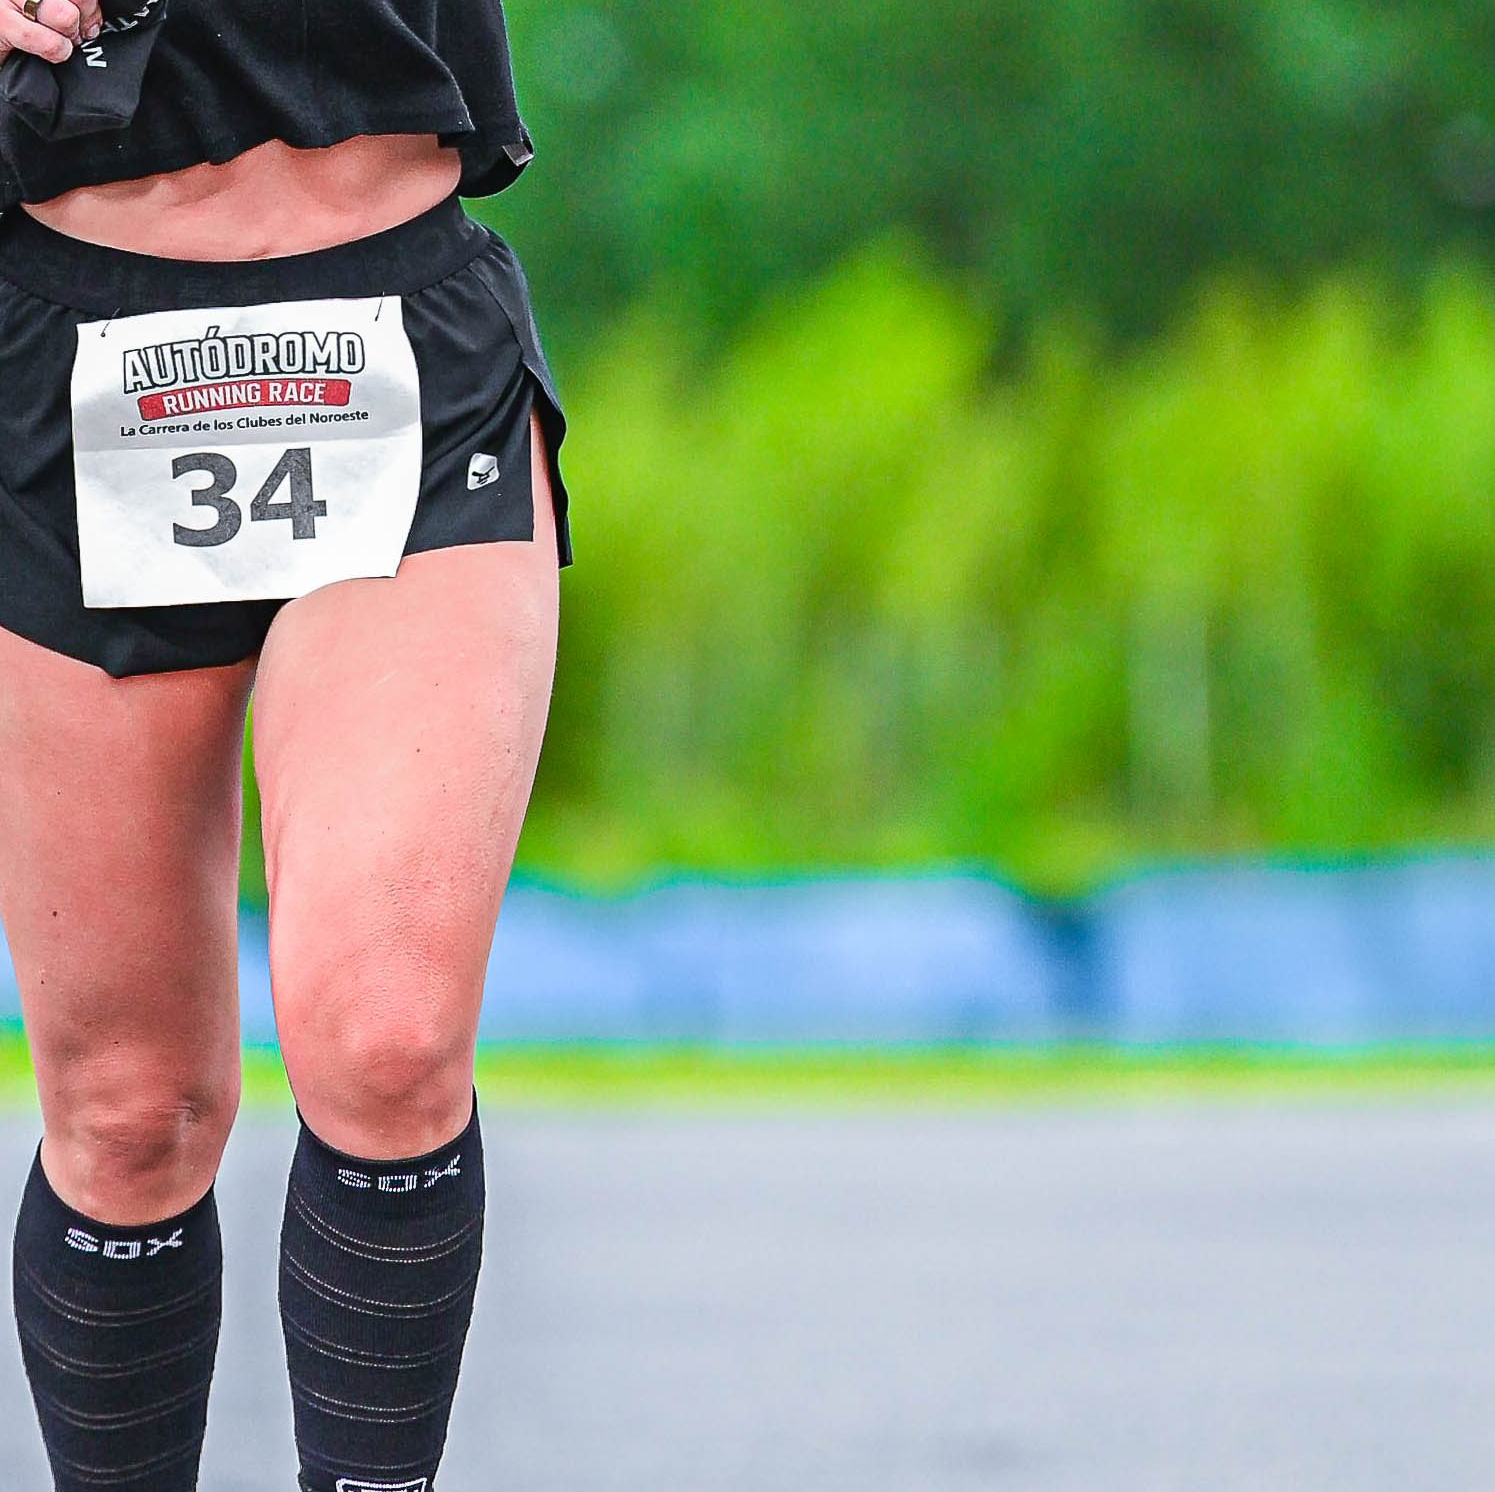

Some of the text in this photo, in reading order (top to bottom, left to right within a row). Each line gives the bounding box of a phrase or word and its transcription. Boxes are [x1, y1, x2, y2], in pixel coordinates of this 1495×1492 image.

[122, 325, 366, 395] AUTÓDROMO
[161, 380, 327, 416] RUNNING RACE
[120, 409, 370, 437] La Carrera de los Clubes del Noroeste
[171, 447, 328, 548] 34
[336, 1154, 461, 1192] SOX
[64, 1226, 183, 1260] SOX
